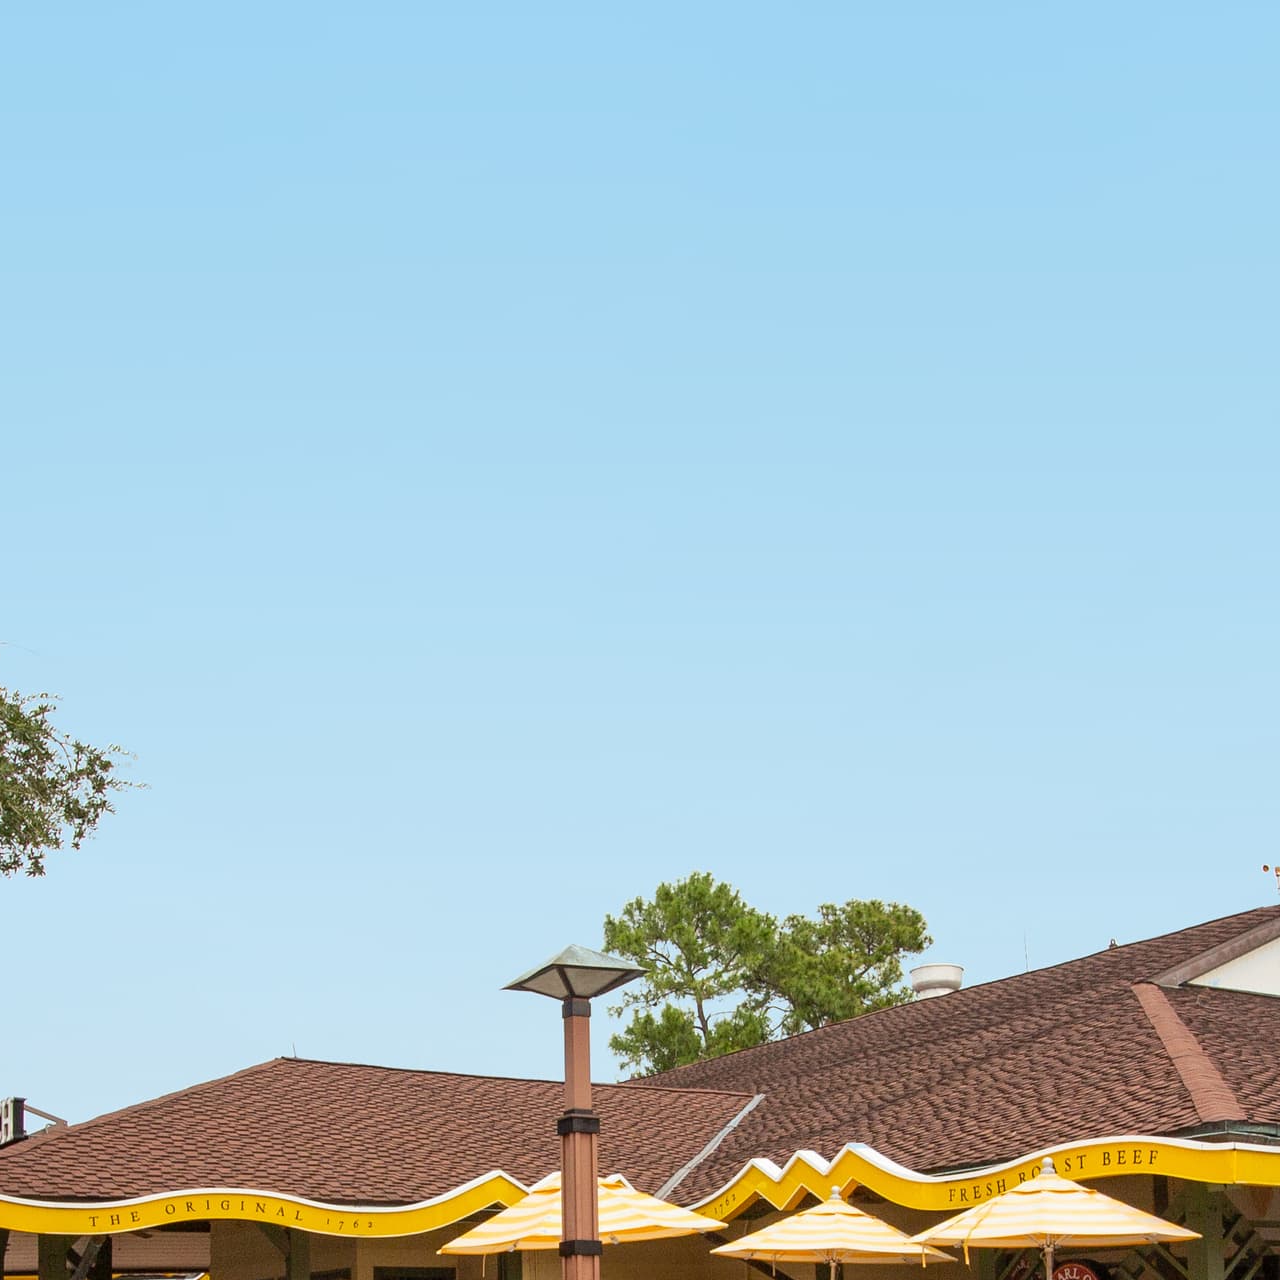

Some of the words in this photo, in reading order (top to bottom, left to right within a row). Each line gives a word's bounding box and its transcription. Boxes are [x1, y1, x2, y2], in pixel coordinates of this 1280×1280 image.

[948, 1178, 1007, 1202] FRESH
[1018, 1154, 1088, 1184] ROST
[1103, 1150, 1159, 1167] BEEF
[88, 1210, 140, 1228] THE
[165, 1199, 303, 1222] ORIGINAL
[326, 1217, 374, 1231] 1762
